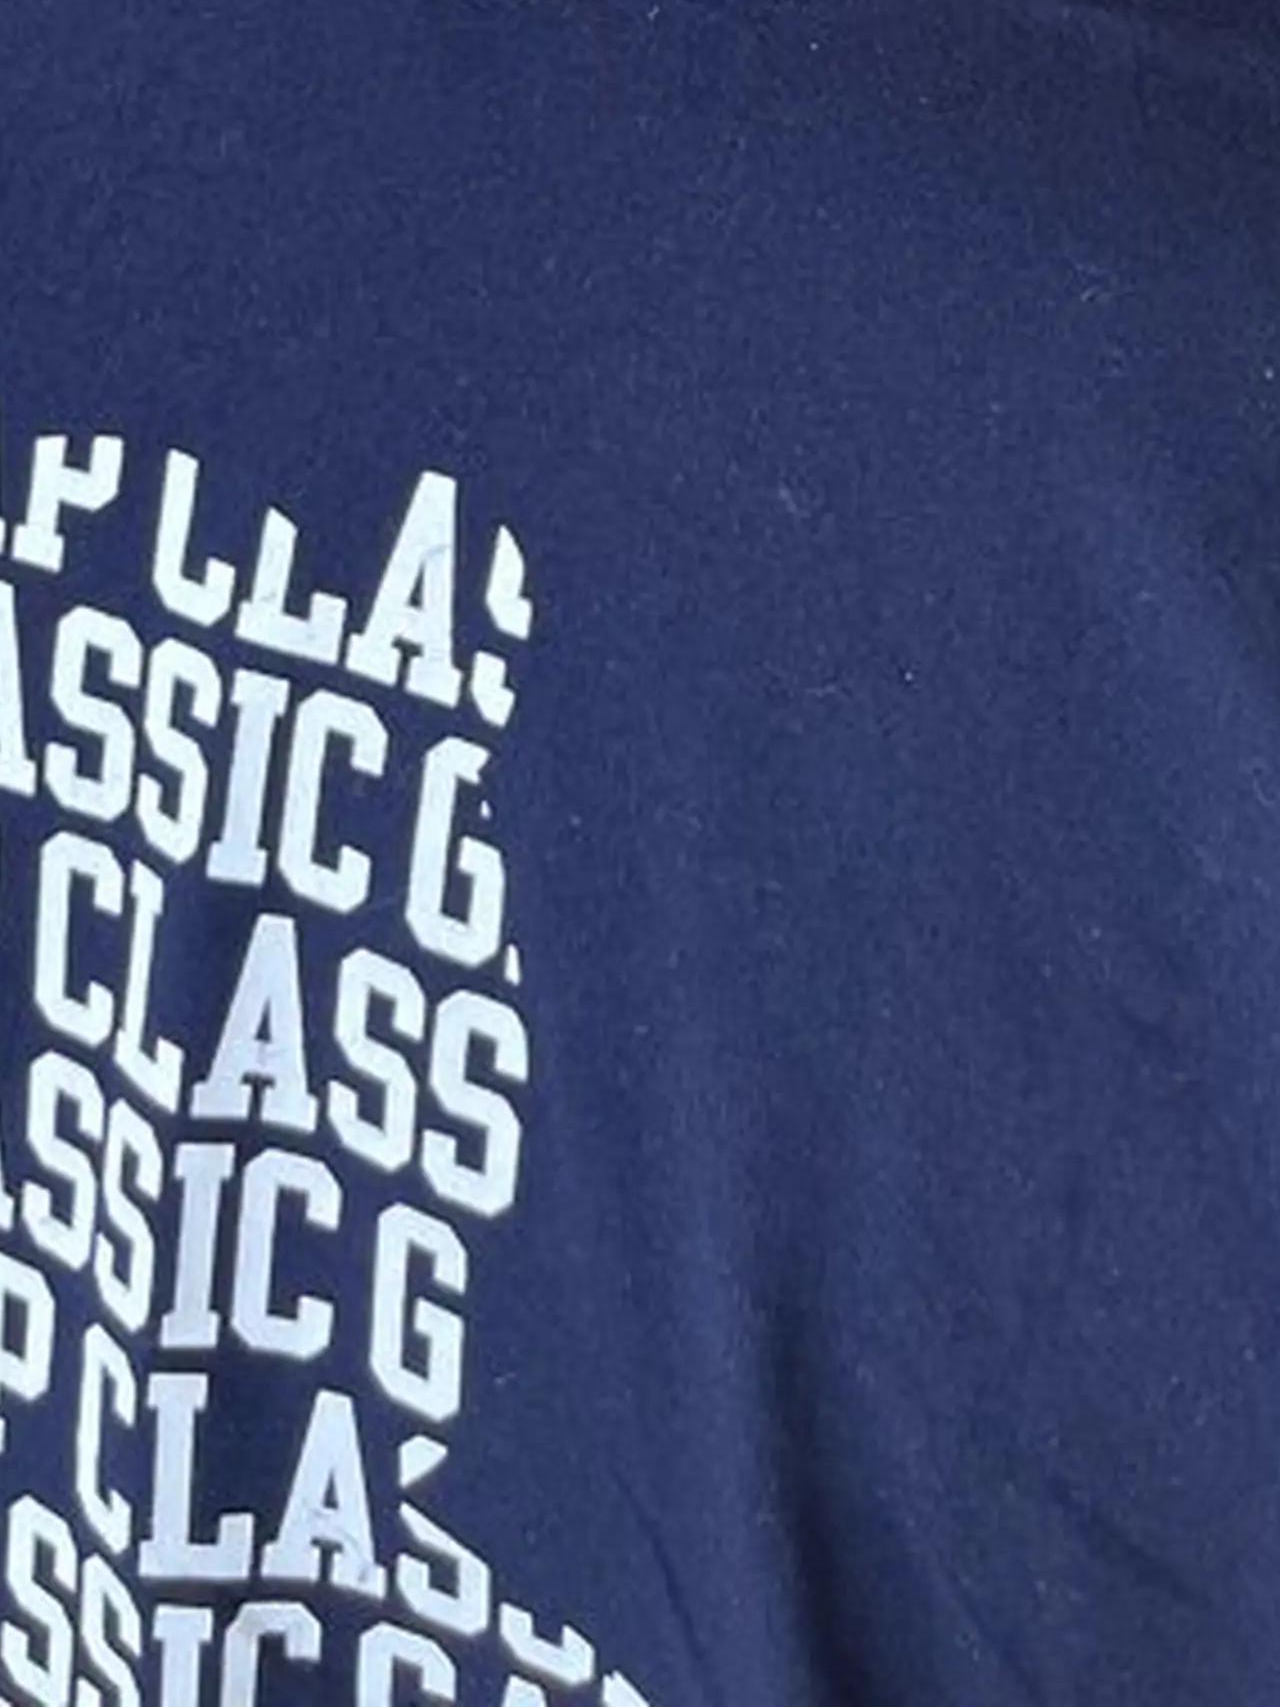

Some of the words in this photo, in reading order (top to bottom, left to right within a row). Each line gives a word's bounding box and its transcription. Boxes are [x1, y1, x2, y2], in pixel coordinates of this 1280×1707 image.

[405, 737, 521, 985] G
[34, 832, 528, 1217] CLASS
[369, 1203, 467, 1422] G
